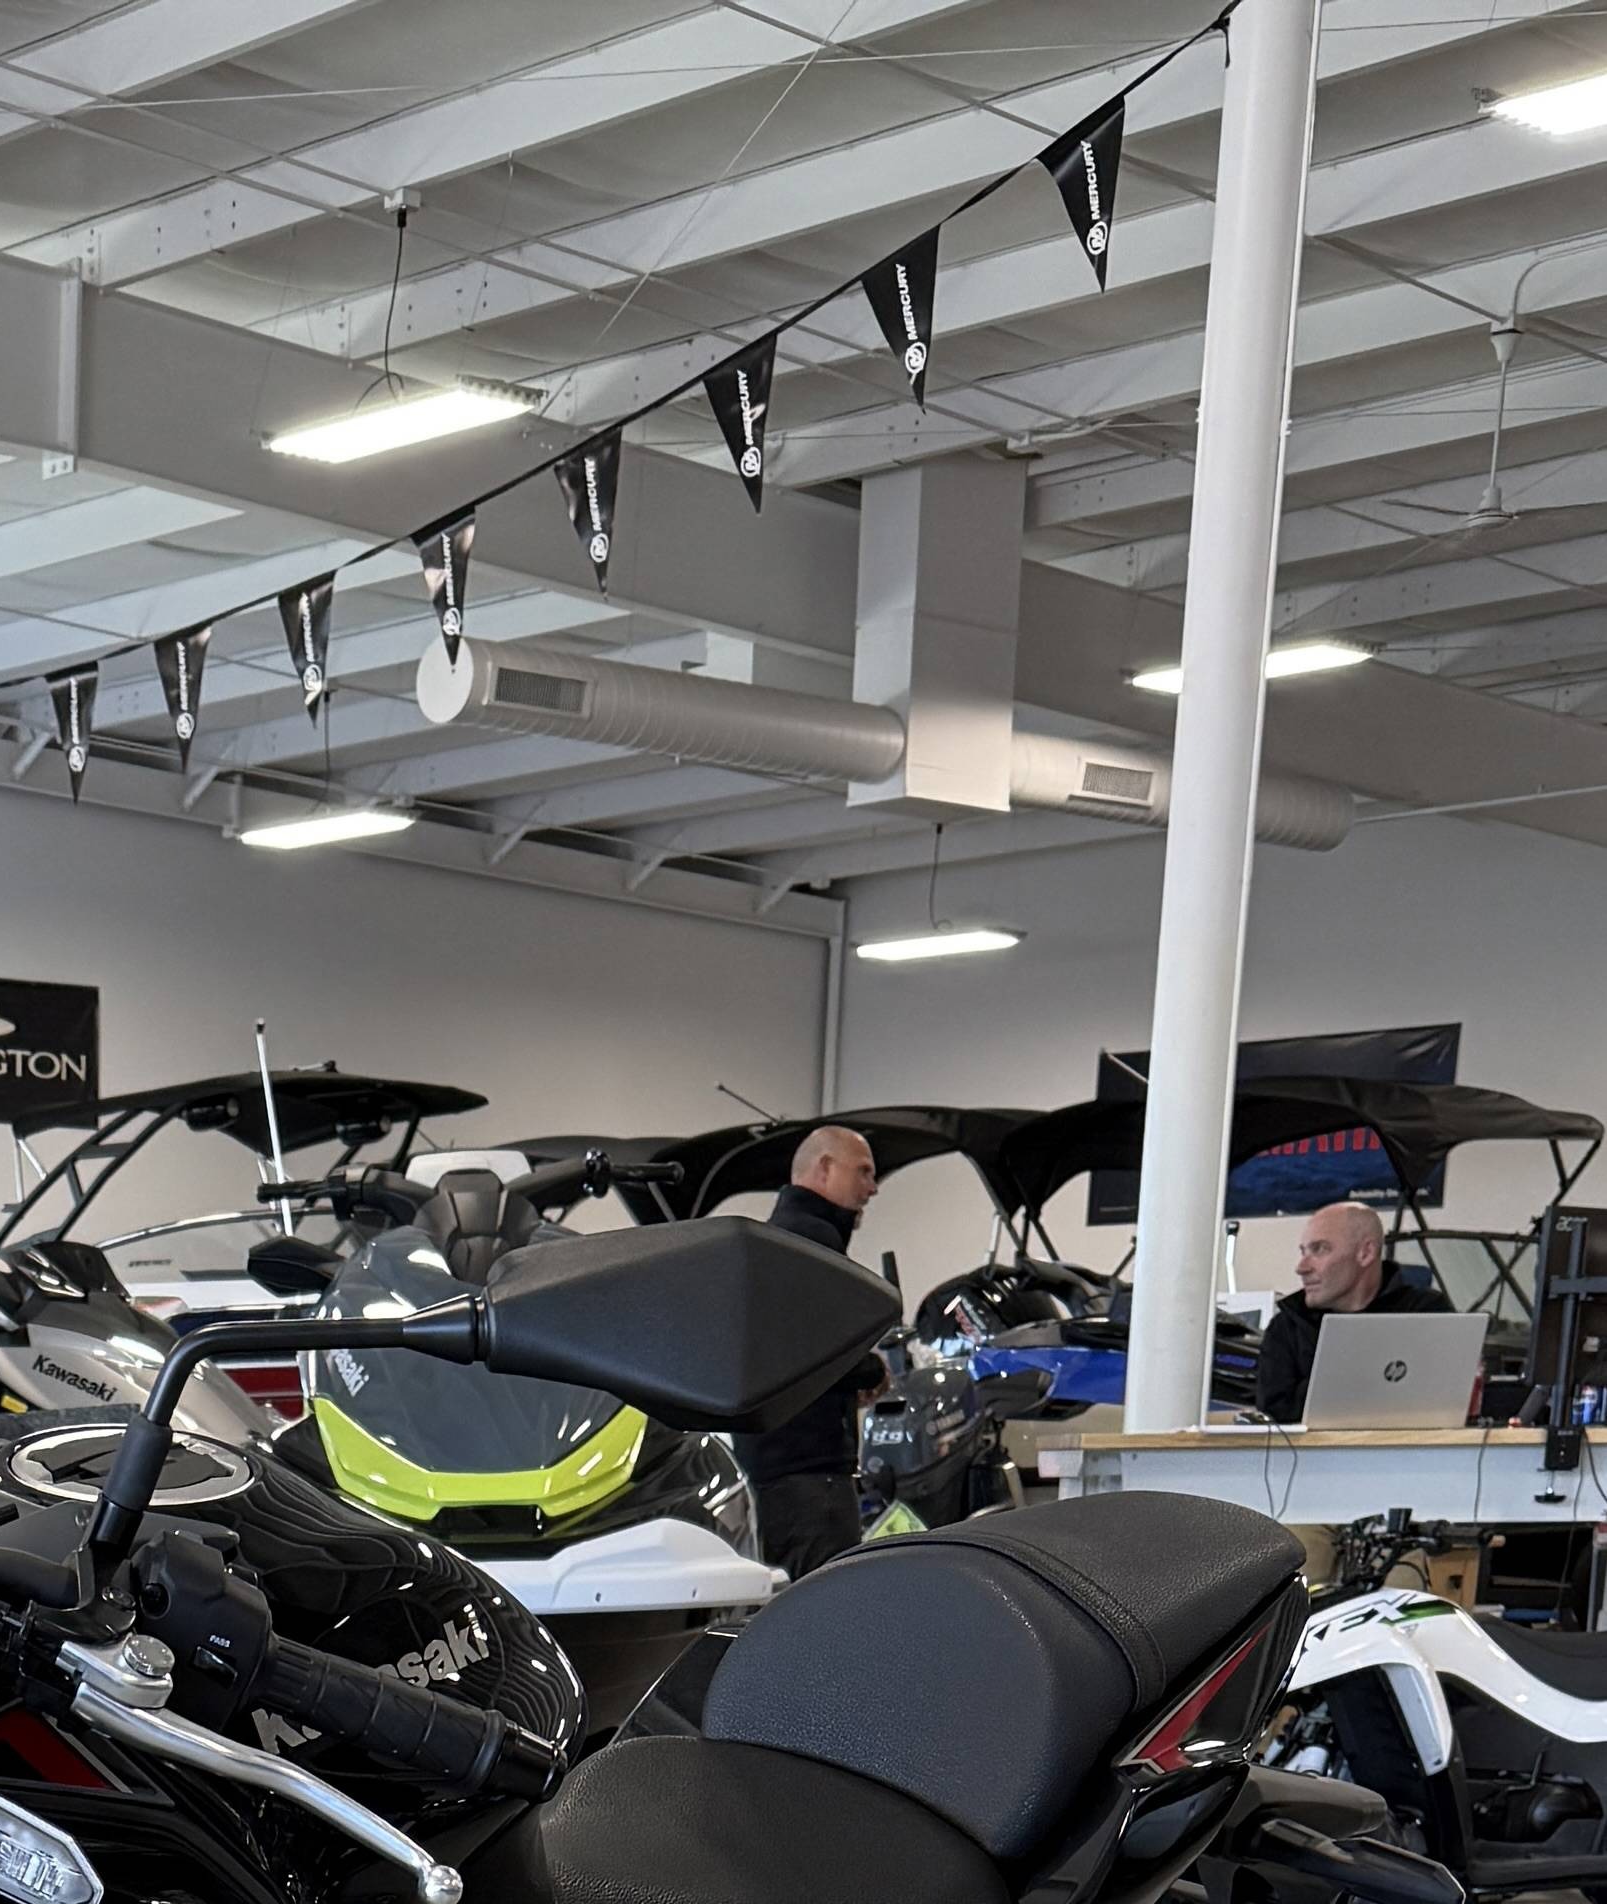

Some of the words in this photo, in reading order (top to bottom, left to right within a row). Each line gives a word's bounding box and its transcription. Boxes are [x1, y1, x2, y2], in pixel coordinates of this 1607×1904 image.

[1080, 140, 1101, 220] MERCURY
[895, 263, 918, 340] MERCURY
[737, 369, 755, 445] MERCURY
[583, 457, 603, 532] MERCURY
[32, 1354, 118, 1402] Kawasaki
